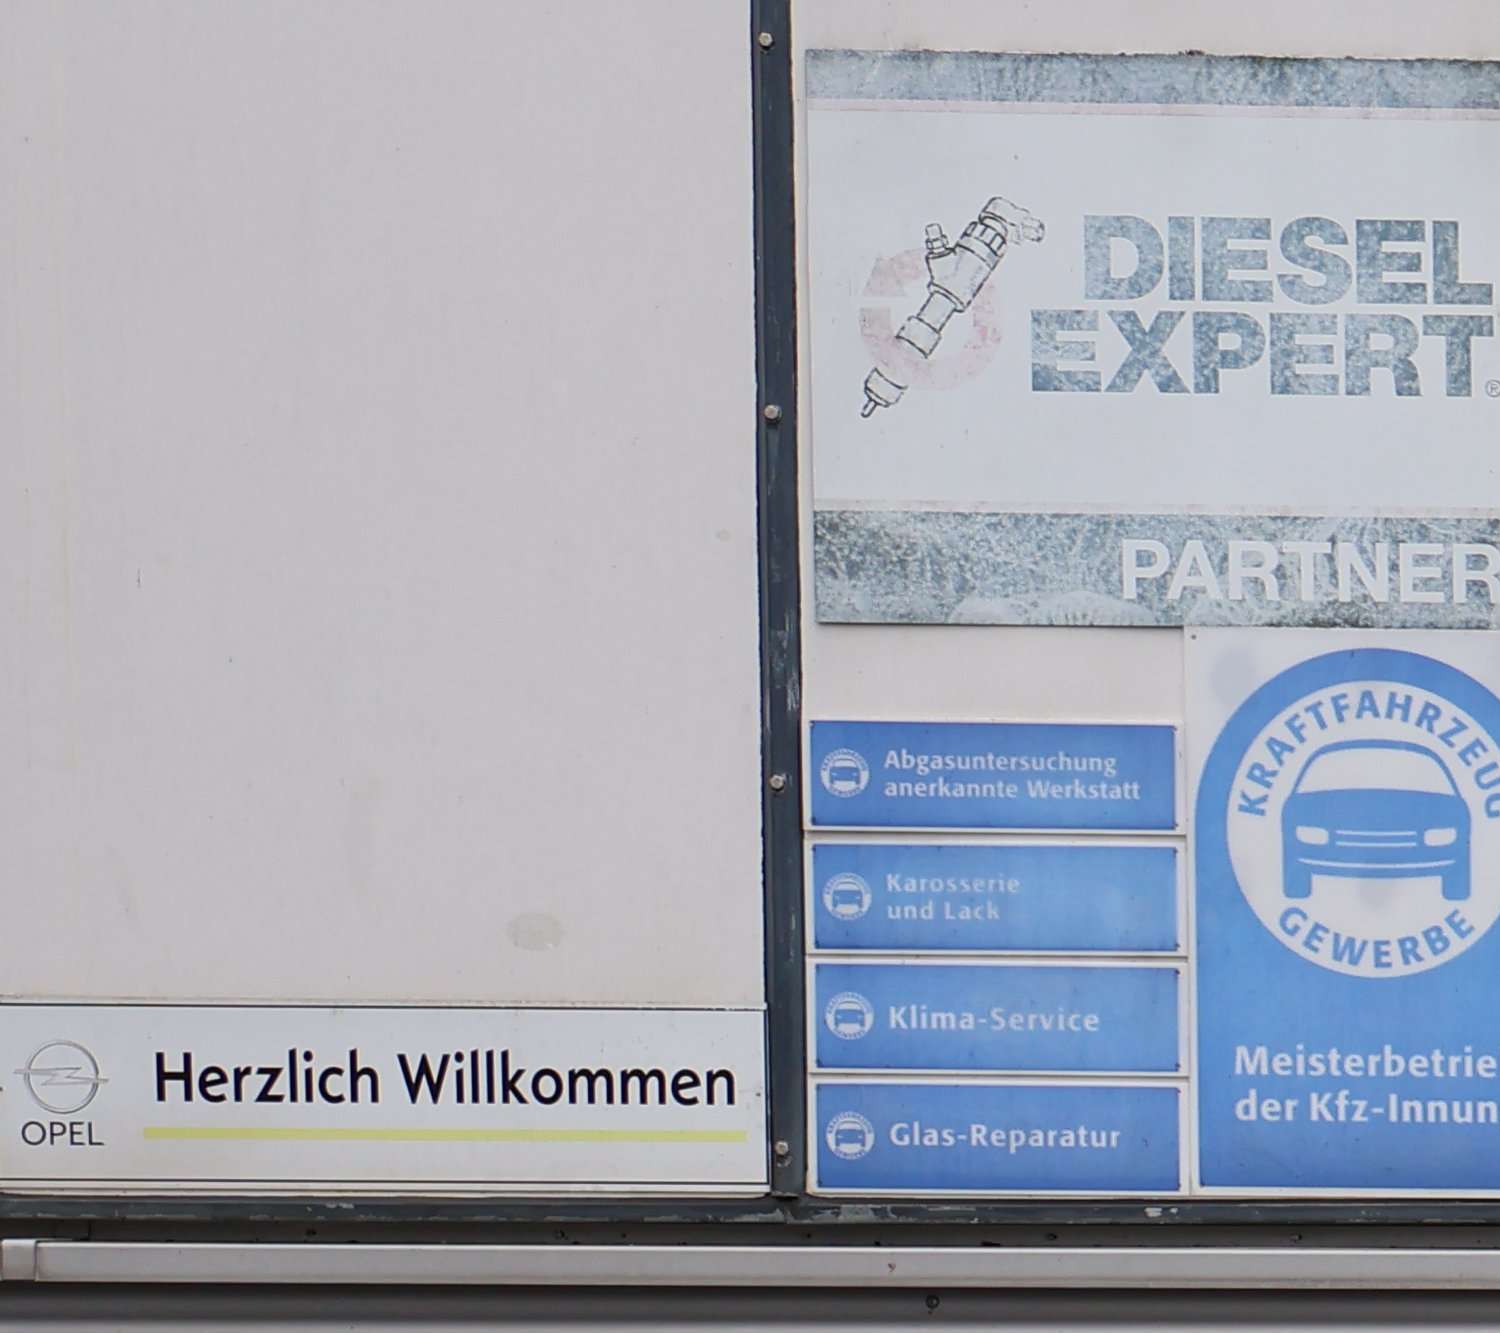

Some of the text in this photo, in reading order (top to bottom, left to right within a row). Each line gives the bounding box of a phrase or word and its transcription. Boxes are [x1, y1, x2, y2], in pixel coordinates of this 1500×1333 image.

[1083, 214, 1494, 305] DIESEL
[1031, 310, 1494, 397] EXPERT
[884, 749, 1117, 778] Abgasuntersuchung
[884, 777, 1140, 800] anerkannte Werkstatt
[886, 873, 1020, 894] Karosserie
[887, 899, 1000, 921] und Lack
[1278, 906, 1476, 969] GEWERBE
[889, 1006, 1099, 1032] Klima-Service
[154, 1048, 735, 1107] Herzlich Willkommen
[1235, 1089, 1298, 1122] der
[21, 1121, 104, 1147] OPEL
[889, 1121, 1120, 1151] Glas-Reparatur
